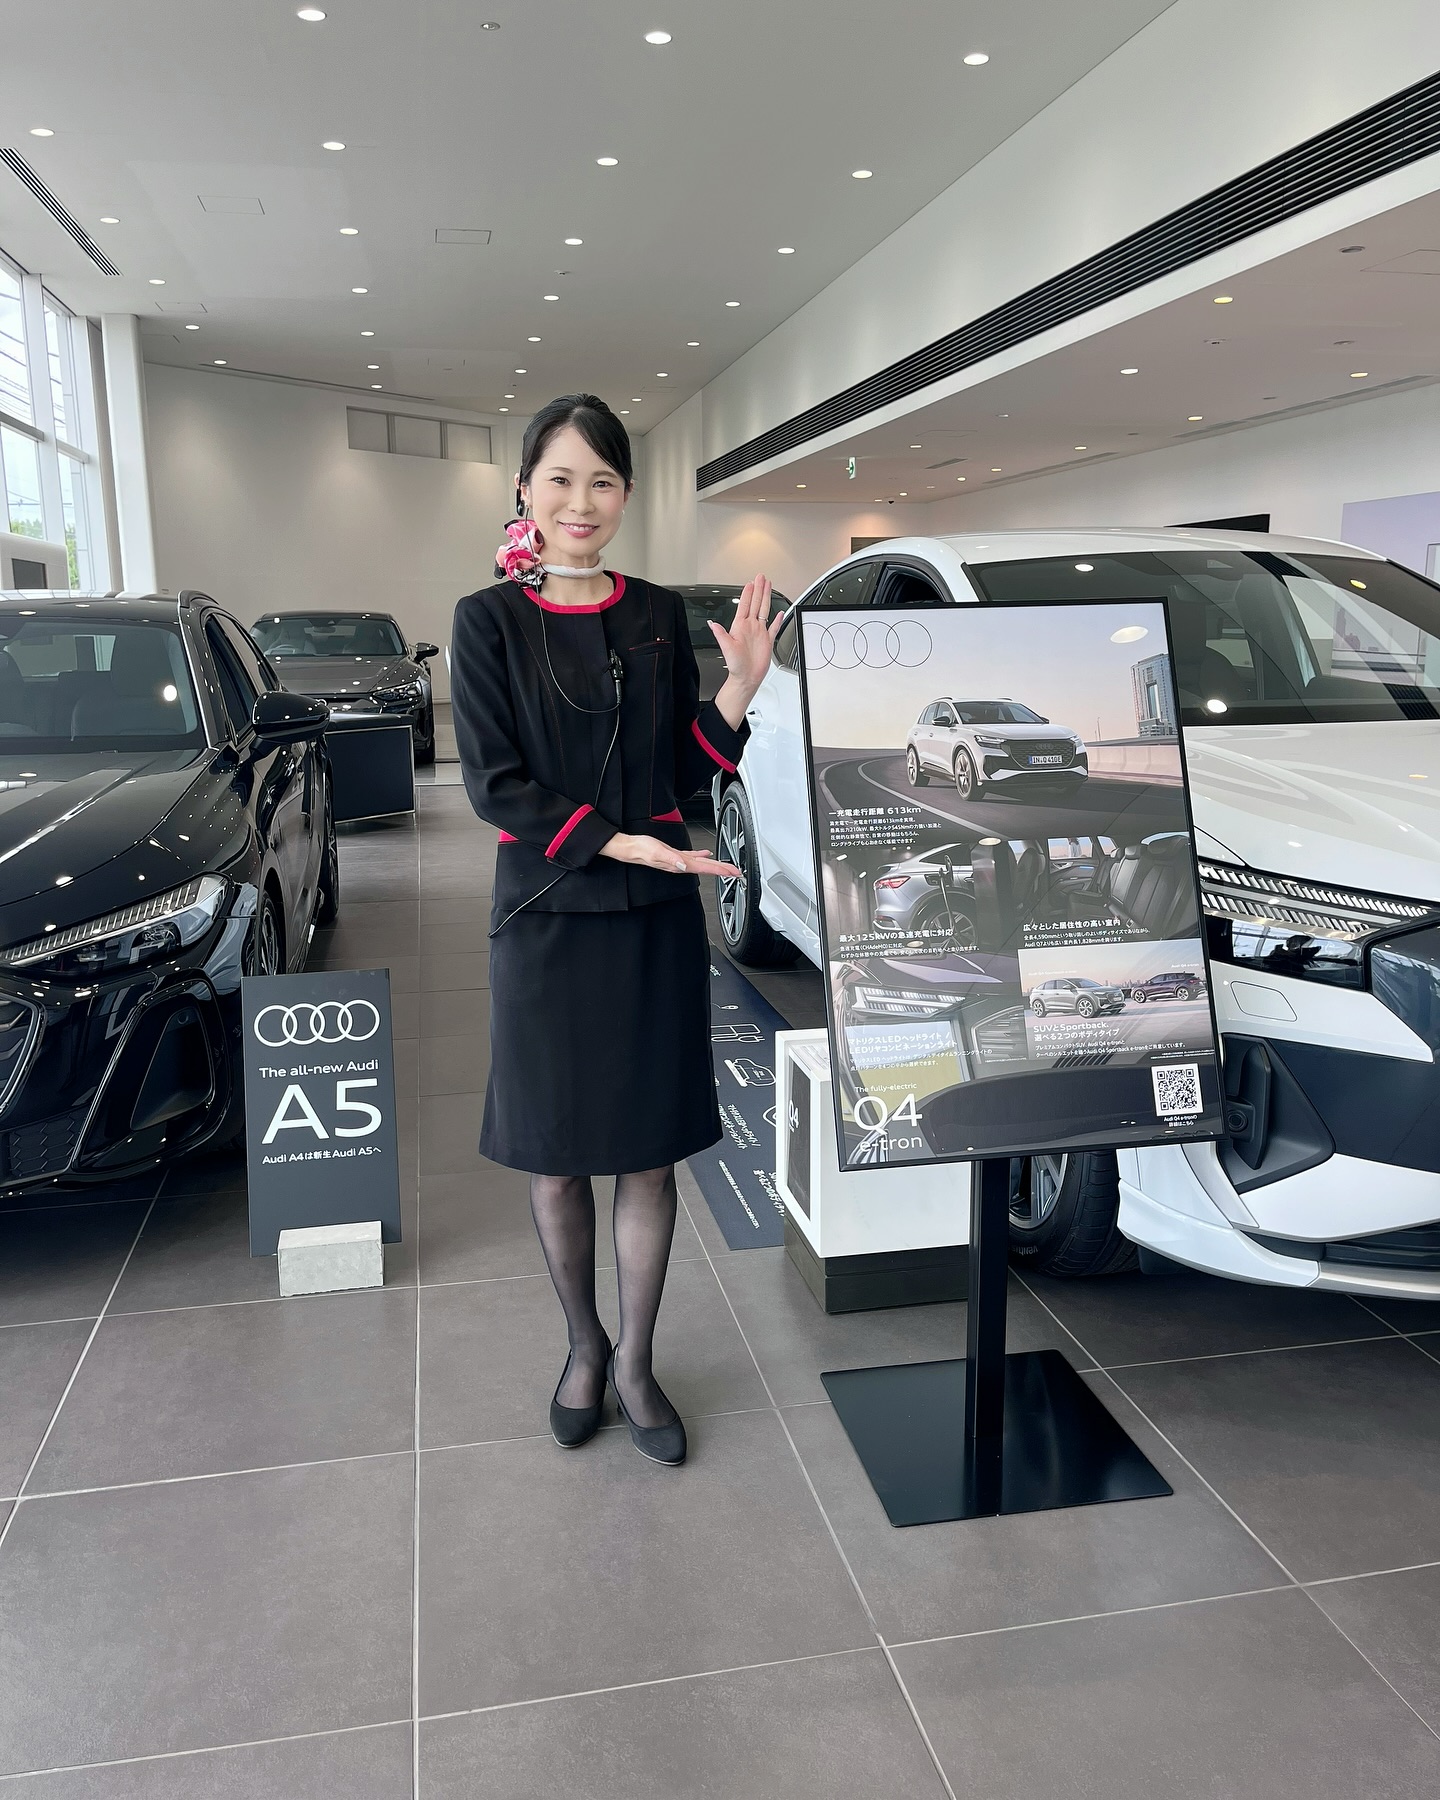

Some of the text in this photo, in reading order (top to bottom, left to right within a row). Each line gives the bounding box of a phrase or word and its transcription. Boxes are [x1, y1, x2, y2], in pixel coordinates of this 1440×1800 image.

[829, 807, 885, 817] 一充電走行距離
[1023, 918, 1121, 931] 広々とした居住性の高い室内
[840, 928, 953, 943] 最大125kWの急速充電に対応
[1033, 1022, 1109, 1032] SUVとSportback.
[849, 1032, 941, 1045] マトリクスLEDヘッドライト
[1034, 1028, 1120, 1041] 選べる2つのボディタイプ
[850, 1040, 957, 1054] LEDリヤコンビネーションライト
[259, 1059, 379, 1078] The all-new Audi
[870, 1083, 917, 1092] fully-electric
[262, 1078, 382, 1144] A5
[854, 1093, 922, 1135] Q4
[860, 1136, 922, 1152] e-tron
[262, 1154, 287, 1165] Audi
[358, 1146, 382, 1156] A5へ
